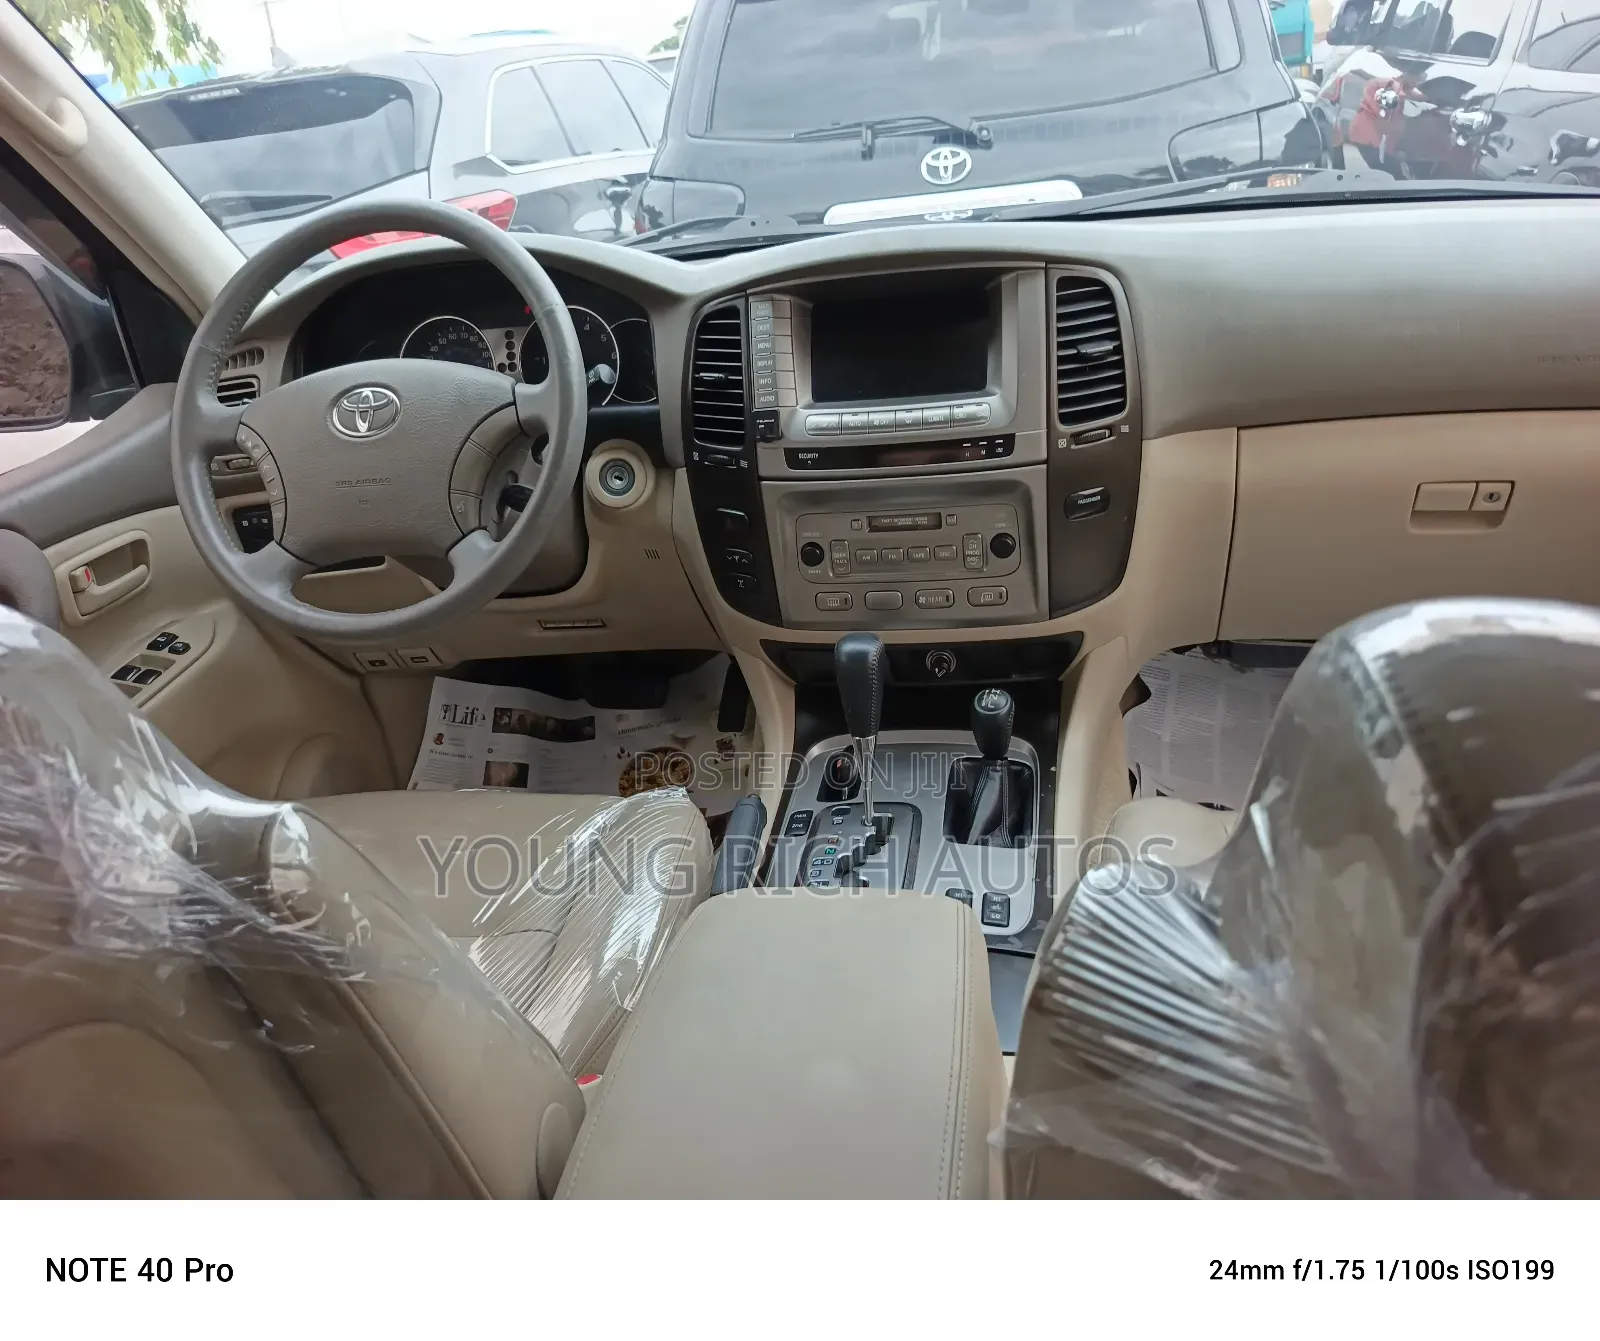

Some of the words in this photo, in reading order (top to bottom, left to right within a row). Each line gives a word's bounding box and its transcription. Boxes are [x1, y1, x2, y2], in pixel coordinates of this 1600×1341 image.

[600, 334, 607, 342] 5
[611, 352, 617, 360] 6
[355, 478, 392, 486] AIRBAG
[450, 704, 486, 727] Life
